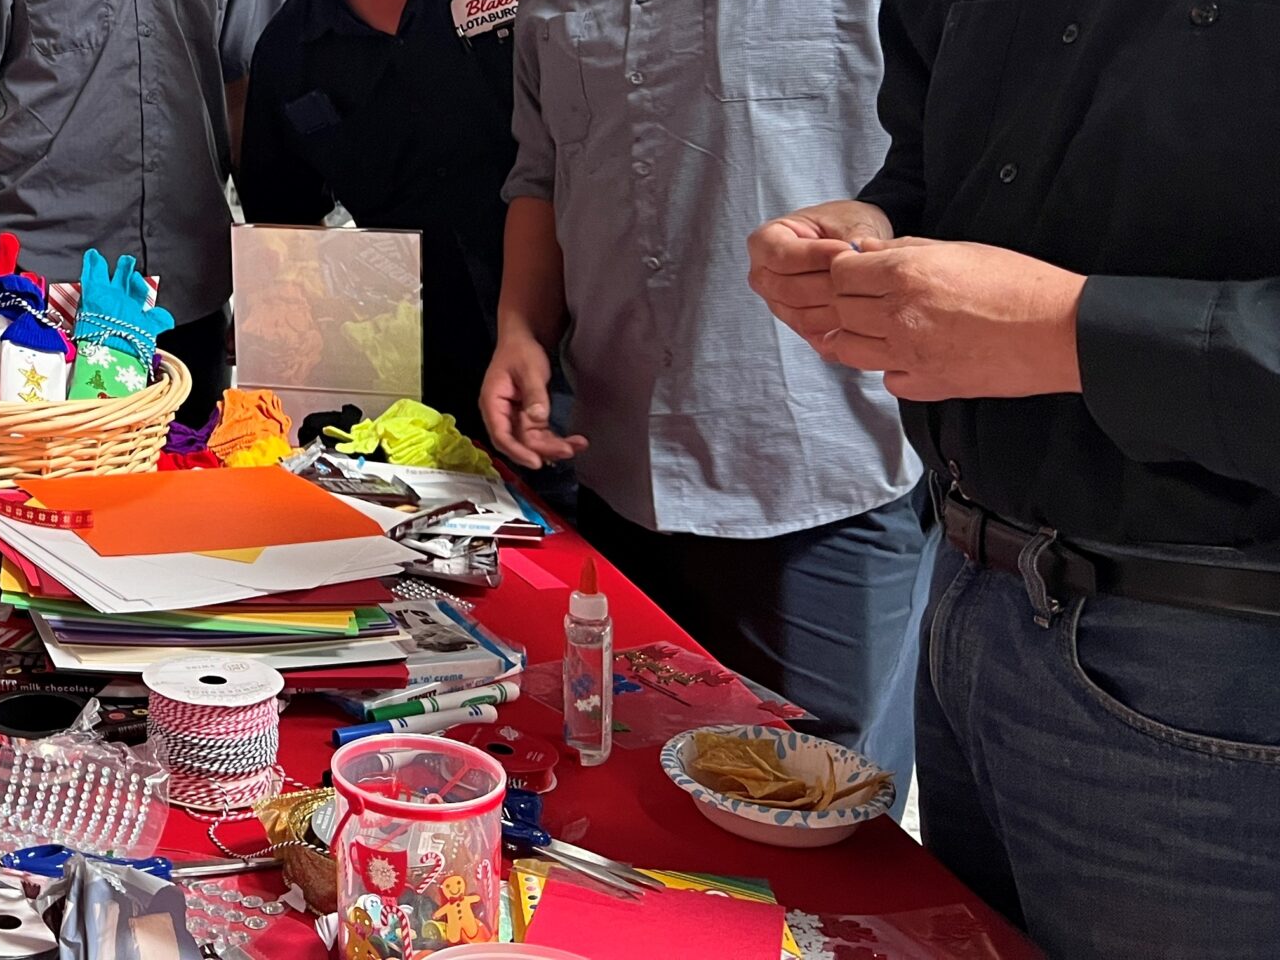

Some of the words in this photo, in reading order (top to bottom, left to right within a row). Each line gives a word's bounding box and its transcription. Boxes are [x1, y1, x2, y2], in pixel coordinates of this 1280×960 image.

[434, 673, 463, 682] creme
[20, 683, 41, 691] milk
[45, 684, 95, 693] chocolate
